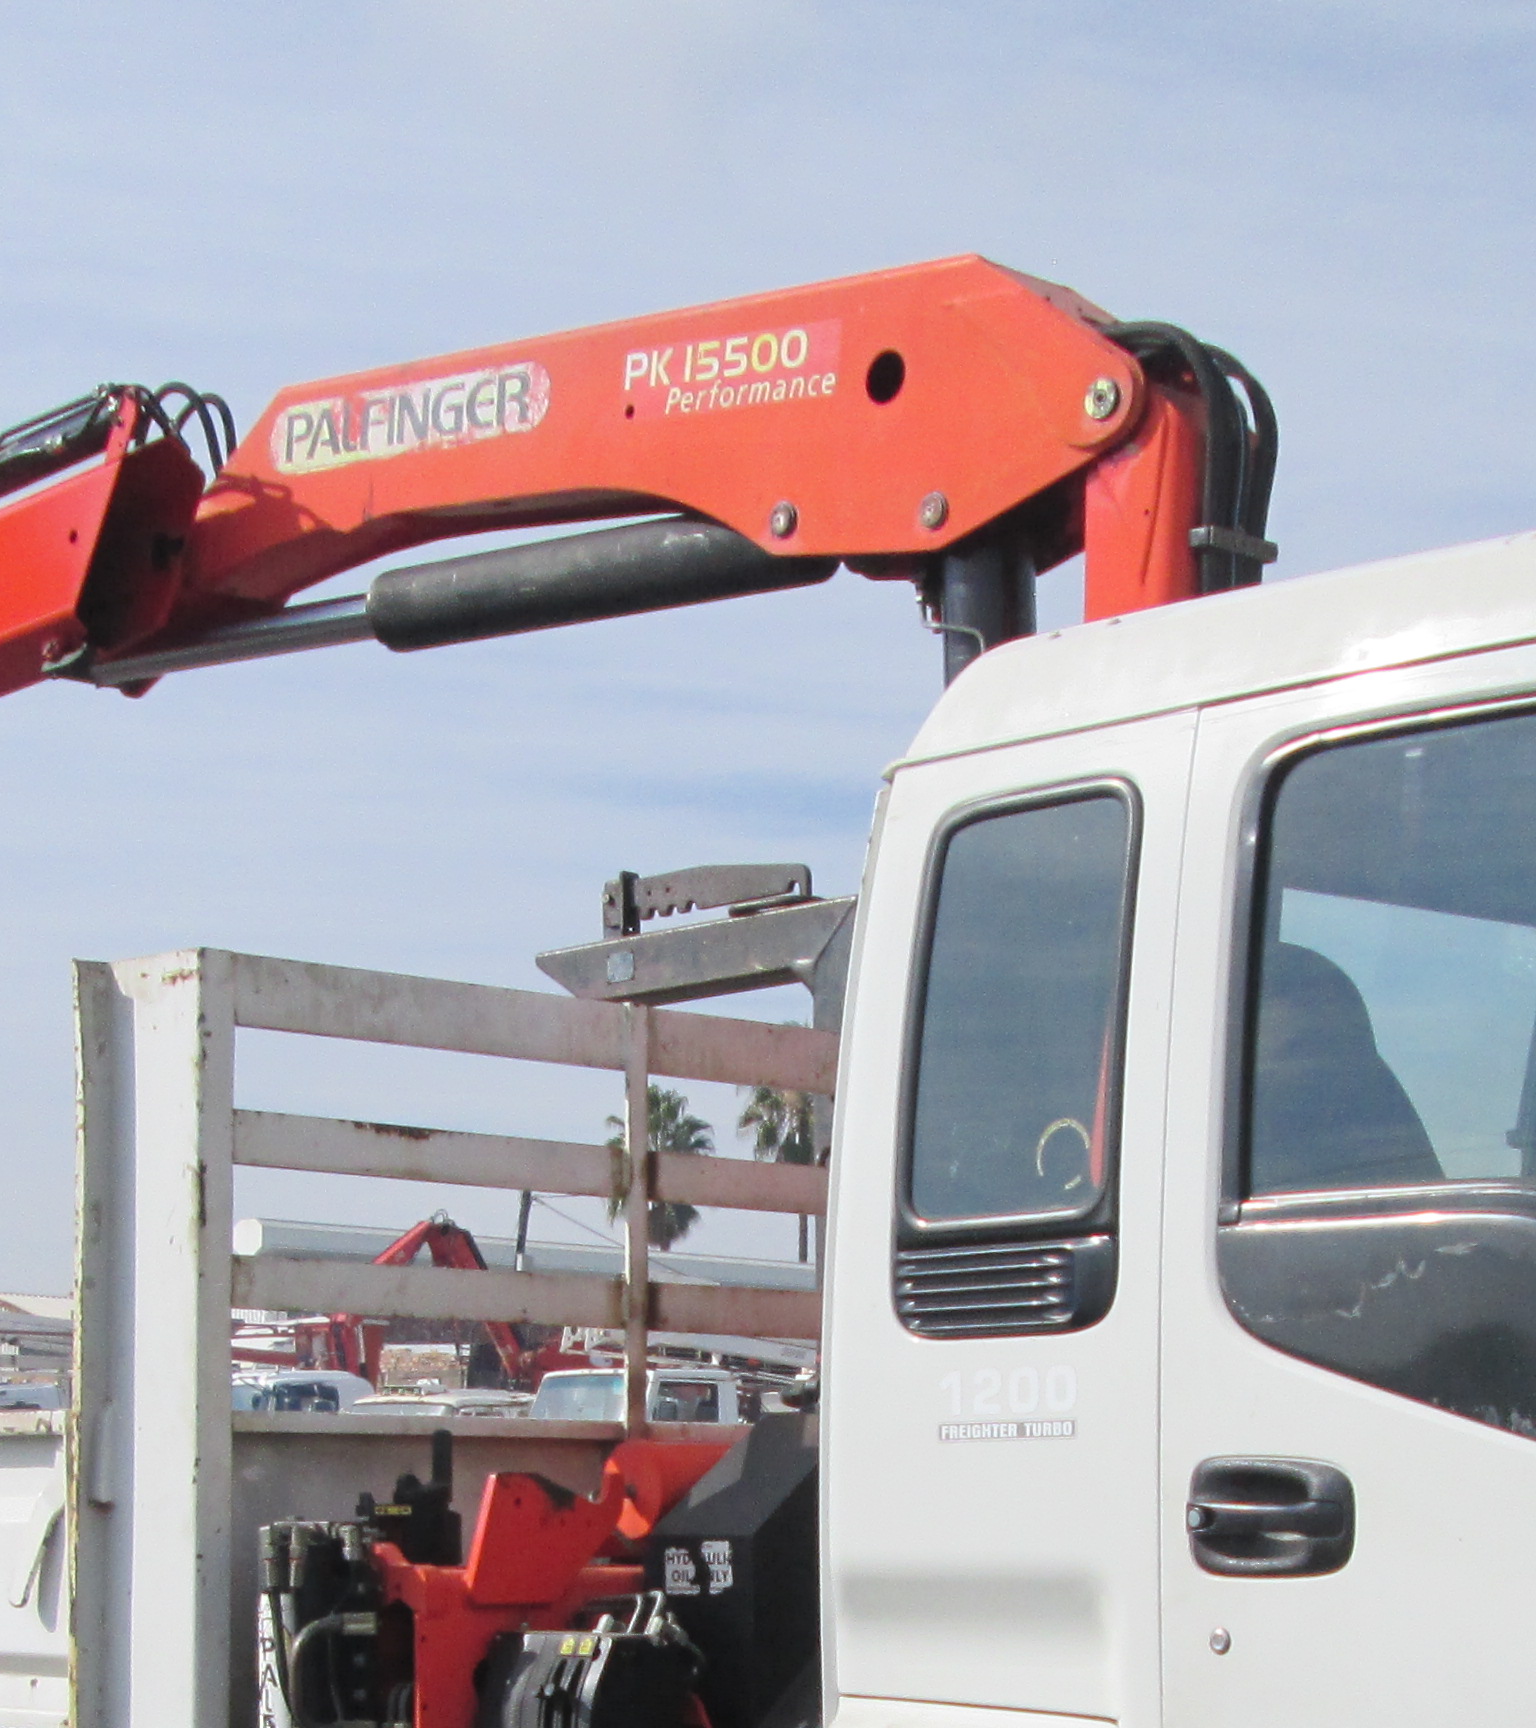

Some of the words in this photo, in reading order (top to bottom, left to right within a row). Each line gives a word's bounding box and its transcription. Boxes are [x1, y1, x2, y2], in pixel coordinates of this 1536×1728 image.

[624, 347, 674, 391] PK
[683, 328, 809, 383] 15500
[283, 370, 532, 464] PALFINGER
[665, 371, 837, 416] Performance
[938, 1364, 1078, 1417] 1200
[940, 1423, 1017, 1440] FREIGHTER
[1023, 1421, 1073, 1438] TURBO
